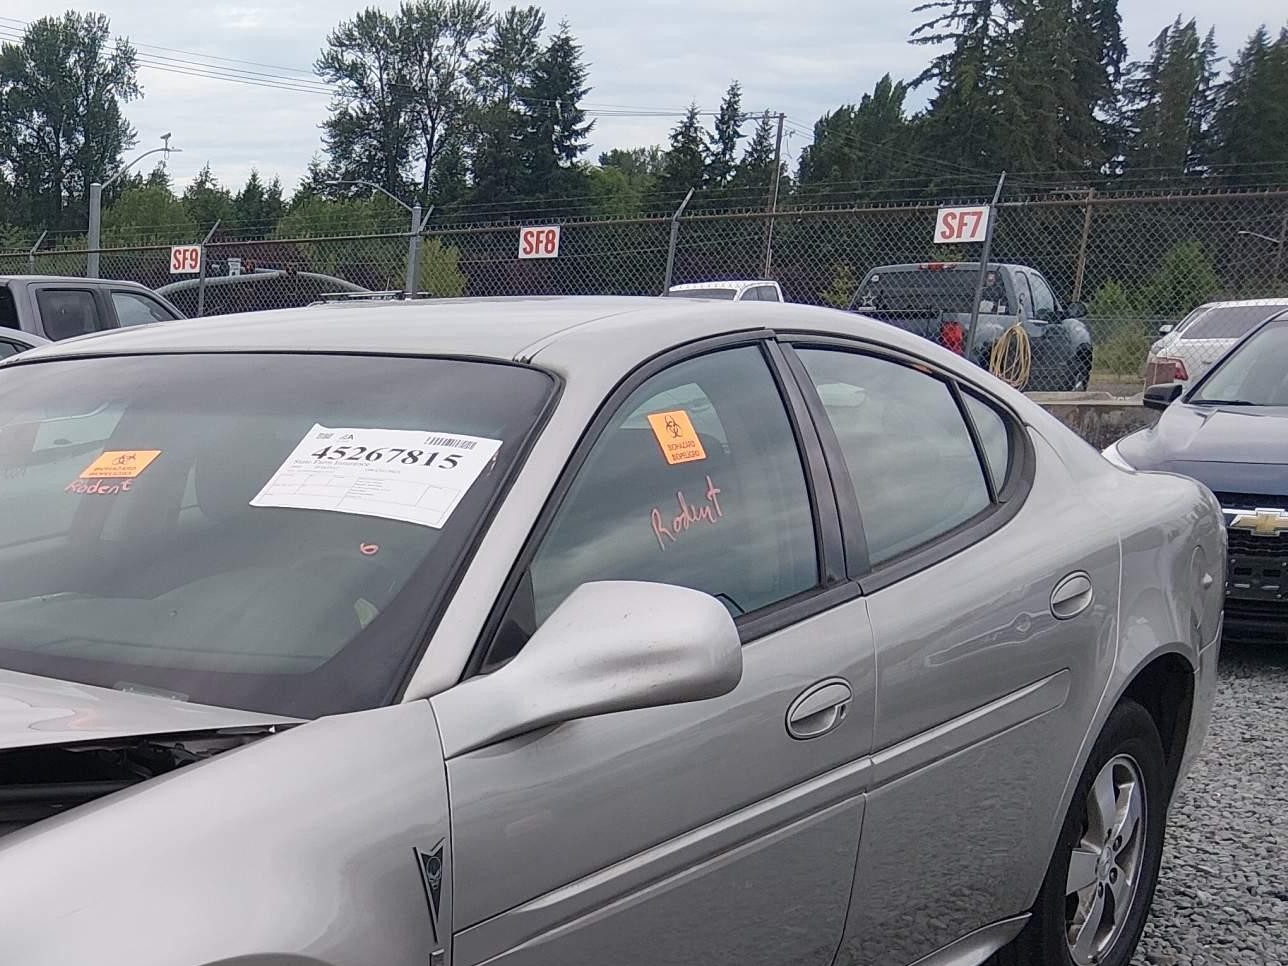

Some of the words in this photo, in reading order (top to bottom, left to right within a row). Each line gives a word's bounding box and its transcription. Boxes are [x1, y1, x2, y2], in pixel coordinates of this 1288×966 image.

[940, 211, 983, 240] SF7
[523, 229, 556, 255] SF8
[173, 248, 199, 270] SF9
[310, 445, 464, 470] 45267815
[65, 479, 133, 494] Rodent
[651, 474, 723, 551] Rodent
